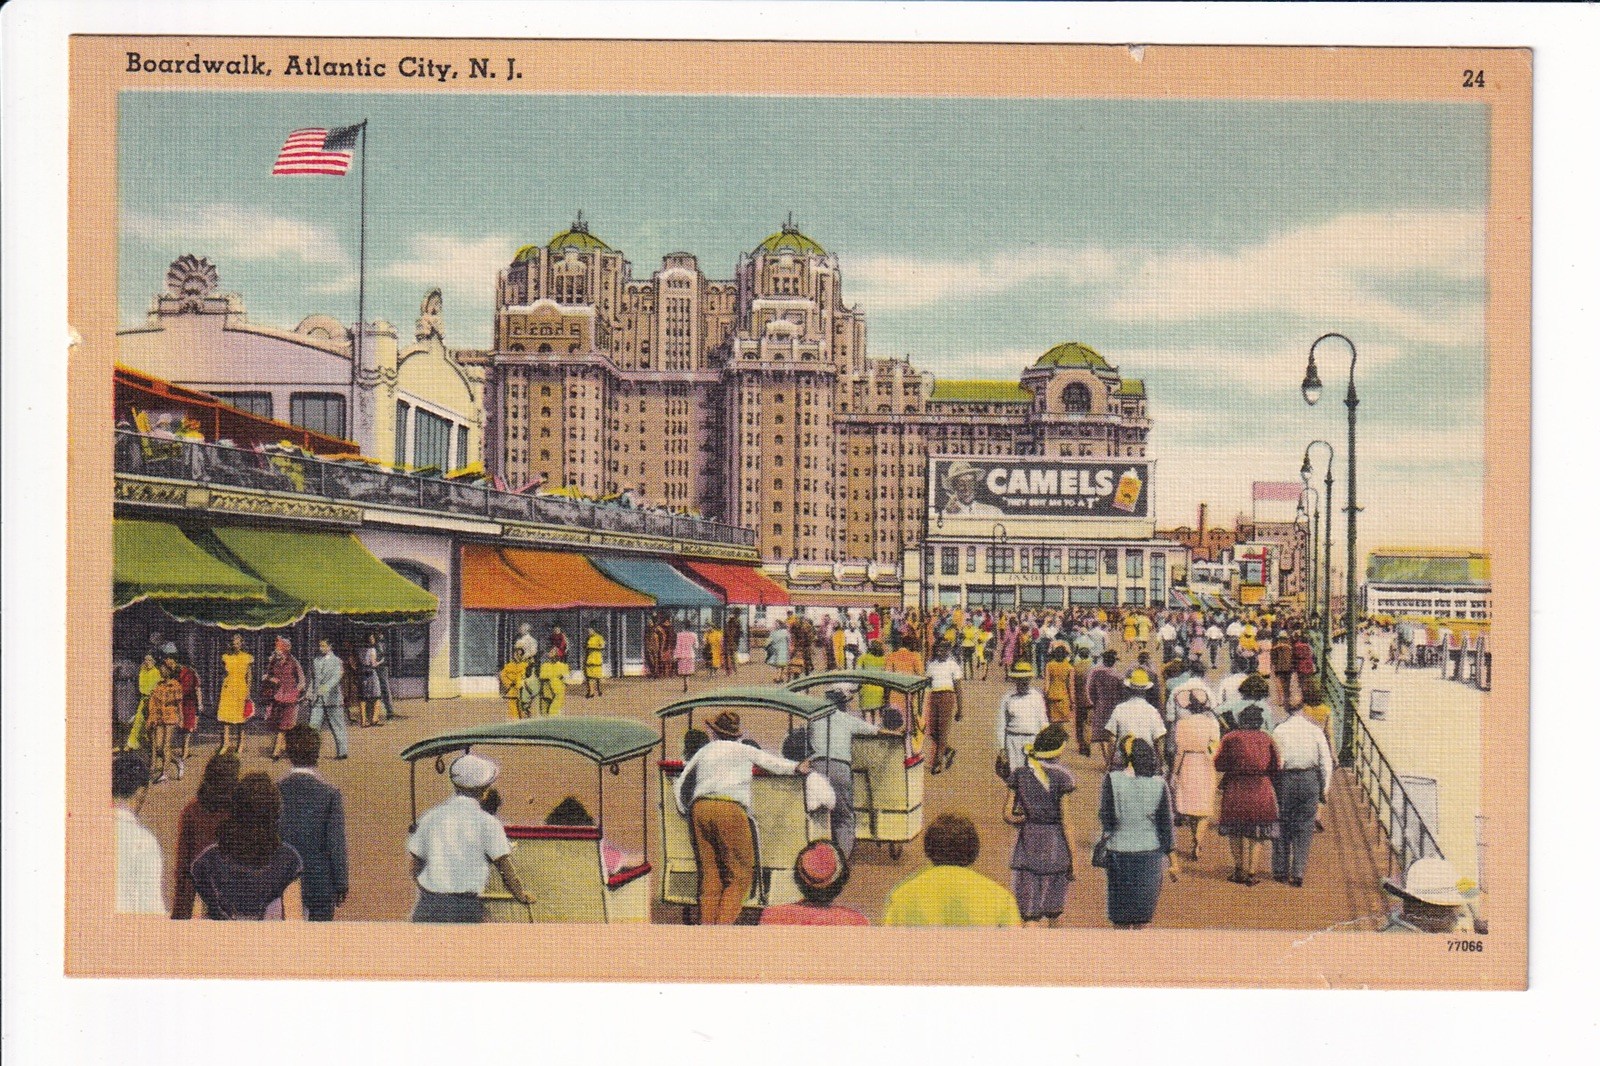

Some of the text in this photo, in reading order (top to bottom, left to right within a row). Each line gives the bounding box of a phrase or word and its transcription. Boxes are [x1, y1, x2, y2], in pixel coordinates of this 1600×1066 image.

[125, 51, 523, 82] Boardwalk, Atlantic City, N. J.
[1462, 69, 1485, 88] 24
[986, 467, 1114, 497] CAMELS
[1447, 940, 1483, 952] 77066
